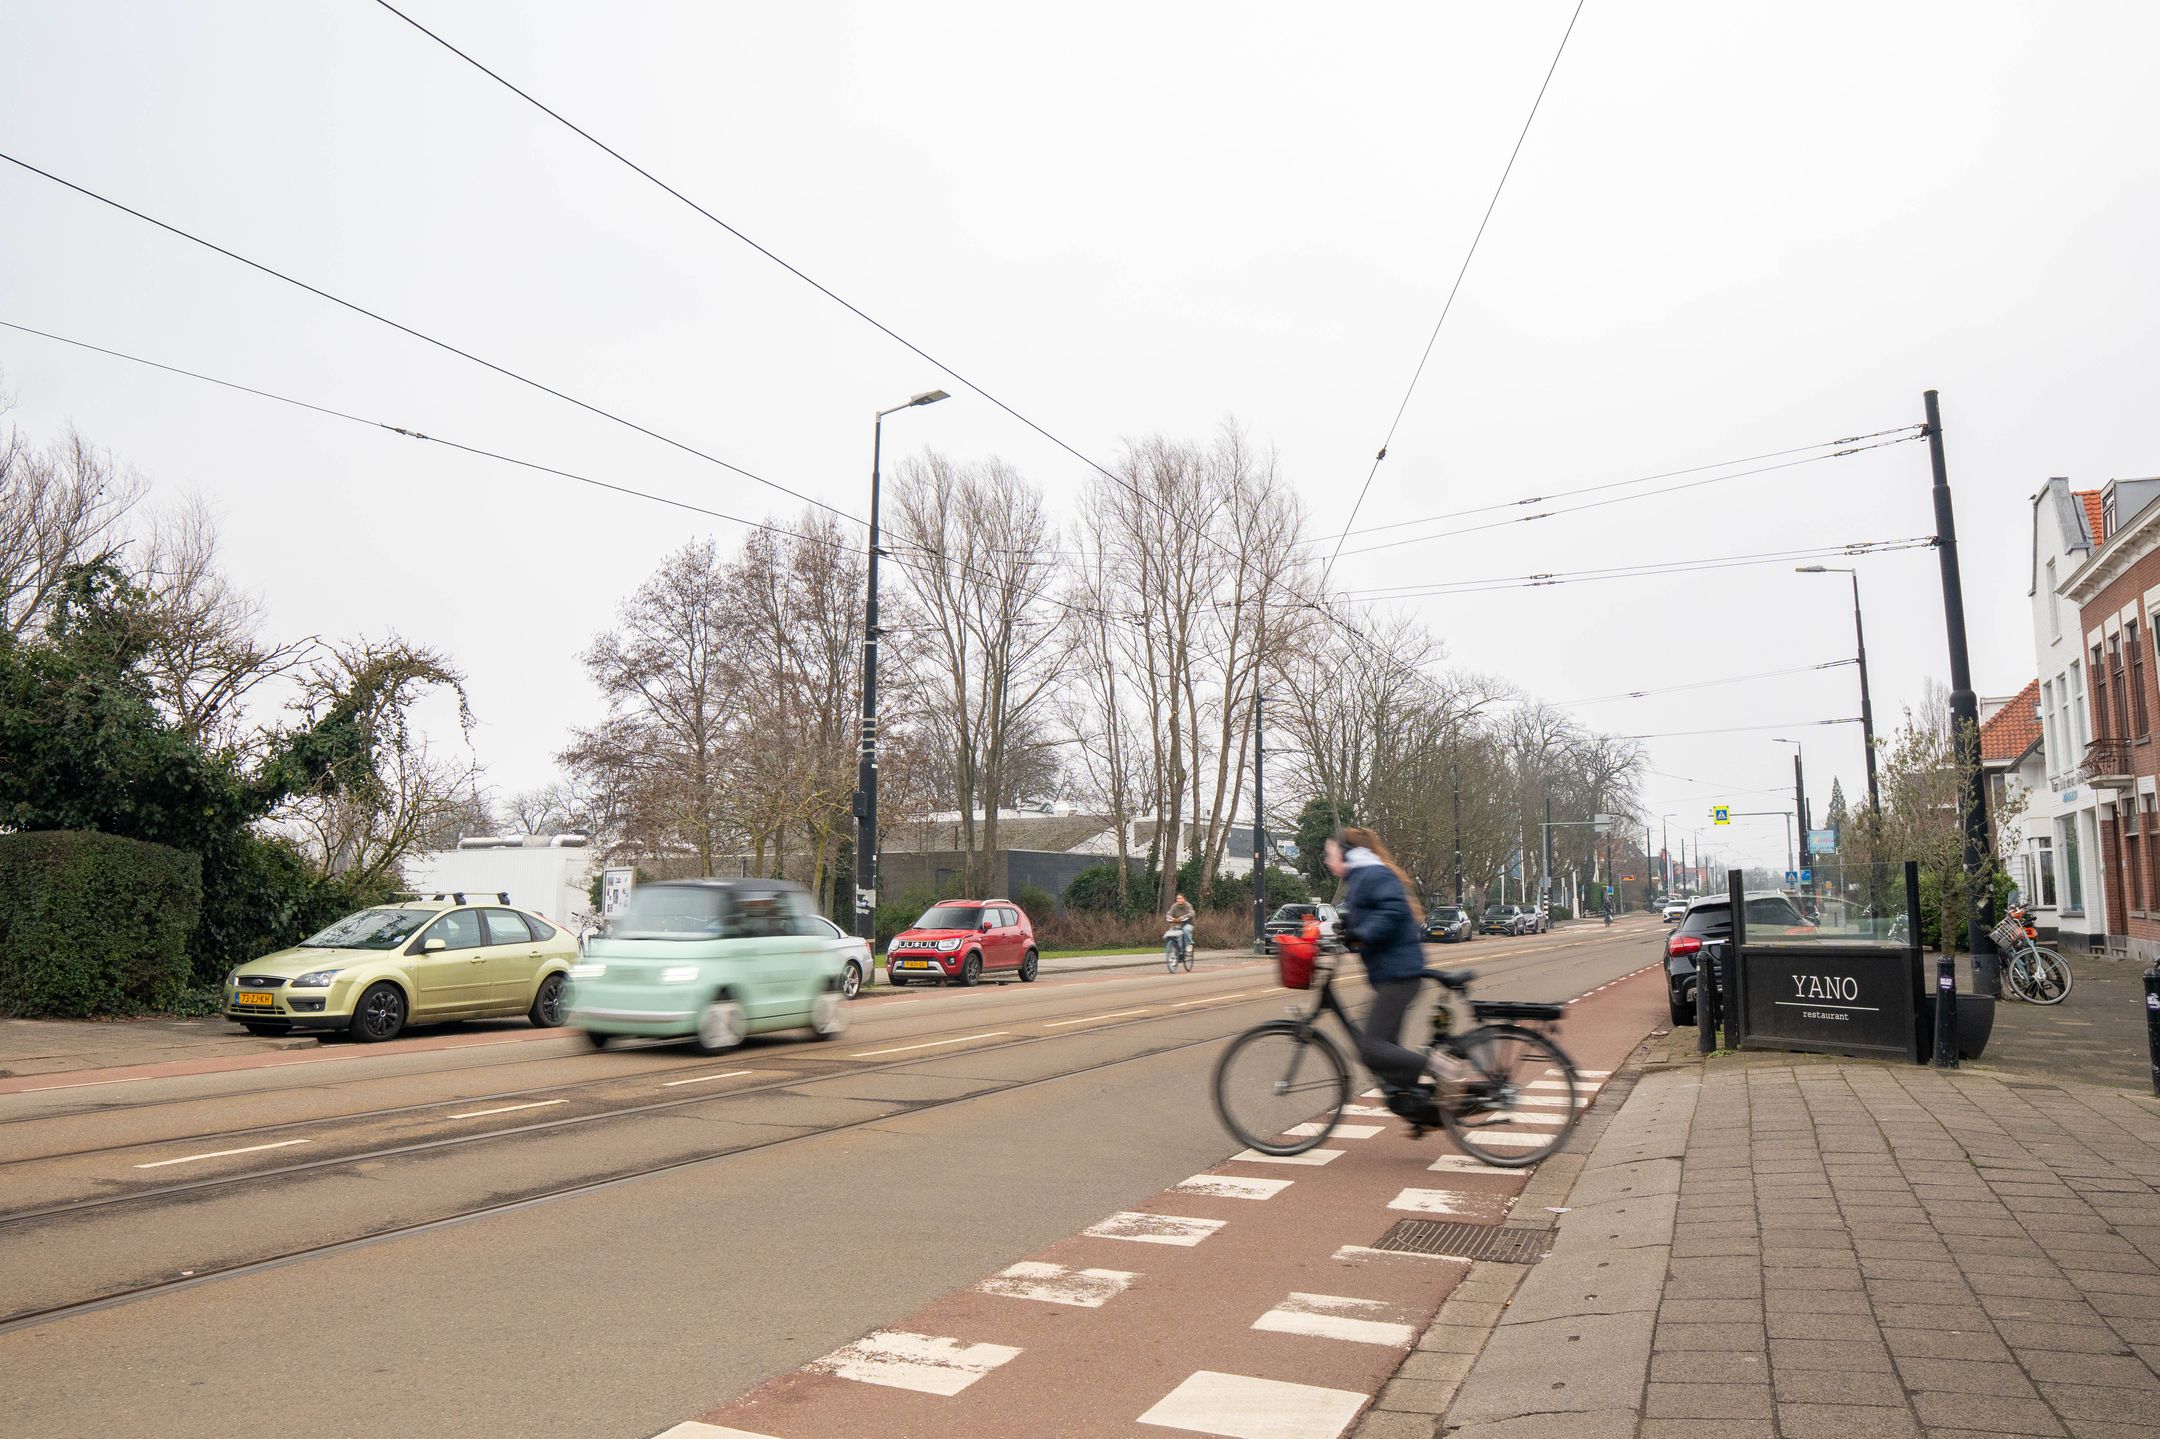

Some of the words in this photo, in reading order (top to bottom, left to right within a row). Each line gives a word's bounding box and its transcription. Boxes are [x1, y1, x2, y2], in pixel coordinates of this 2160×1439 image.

[1792, 975, 1858, 1001] YANO
[241, 994, 270, 1003] 73-ZJ-KH
[1802, 1010, 1849, 1021] restaurant
